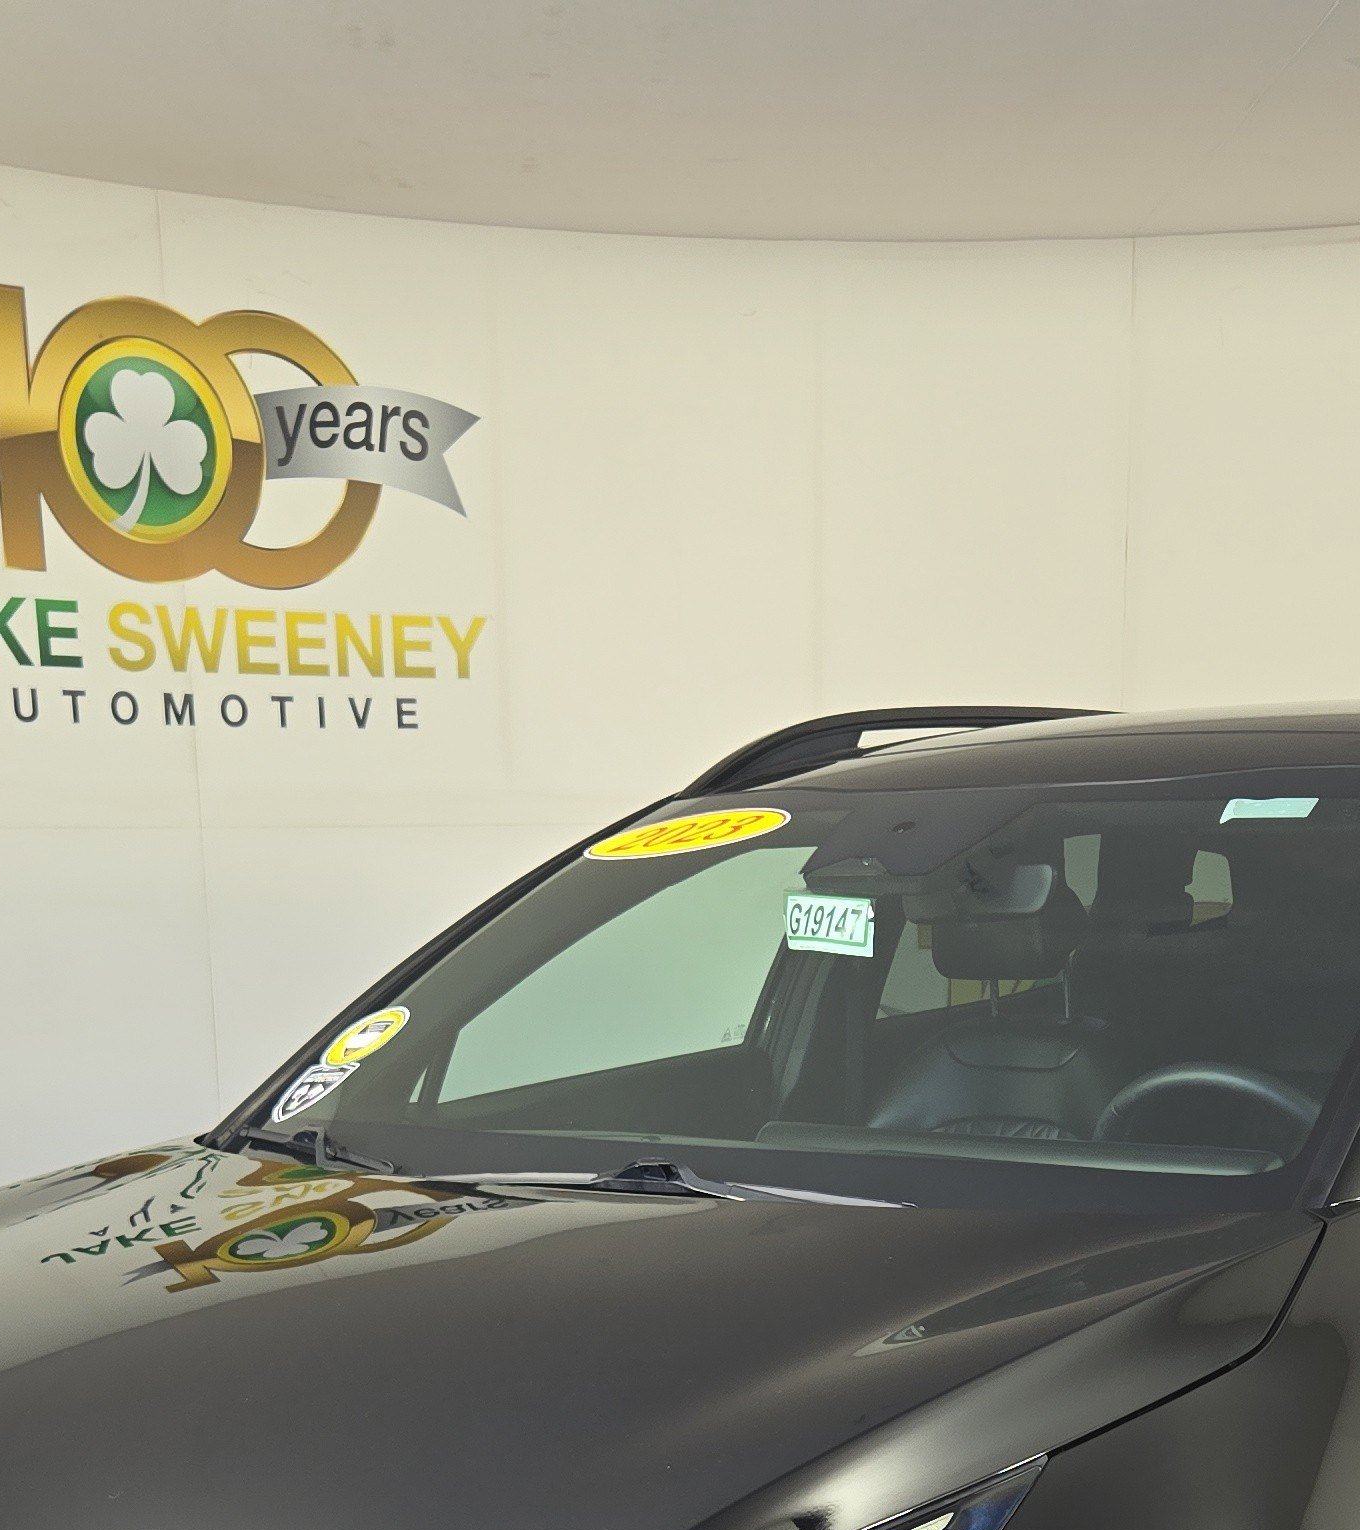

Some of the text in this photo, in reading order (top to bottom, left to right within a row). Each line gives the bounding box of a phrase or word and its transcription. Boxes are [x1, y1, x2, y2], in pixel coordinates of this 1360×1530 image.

[274, 399, 430, 467] years
[107, 601, 487, 680] SWEENEY
[607, 815, 765, 853] 2023
[789, 902, 863, 941] G19147
